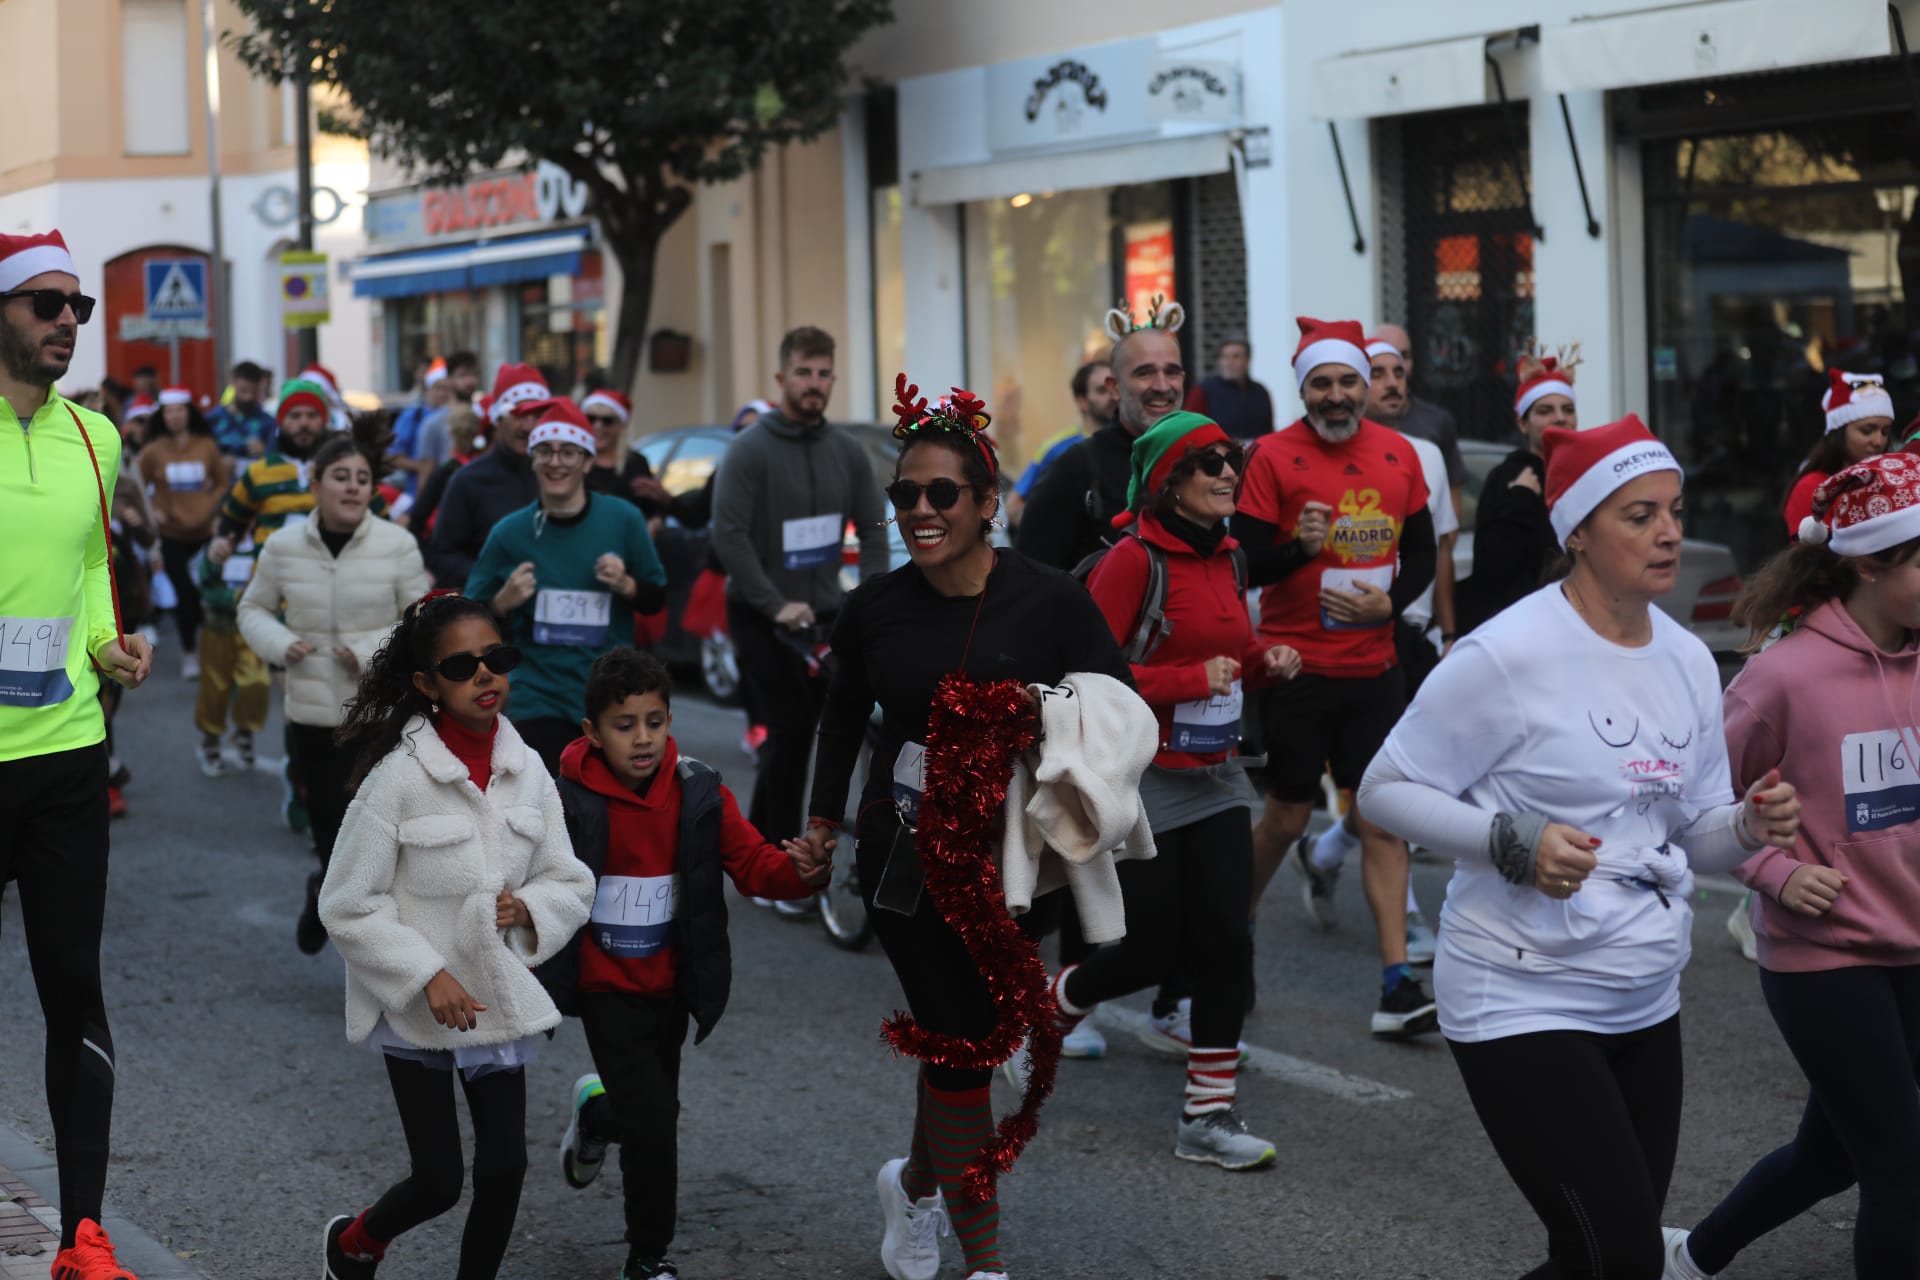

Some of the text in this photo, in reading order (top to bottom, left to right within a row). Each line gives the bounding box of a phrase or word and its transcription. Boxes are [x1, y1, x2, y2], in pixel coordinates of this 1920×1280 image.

[1338, 487, 1382, 519] 42
[1333, 527, 1394, 544] MADRID
[0, 622, 63, 668] 1494
[1858, 738, 1920, 784] 116
[613, 882, 674, 923] 149
